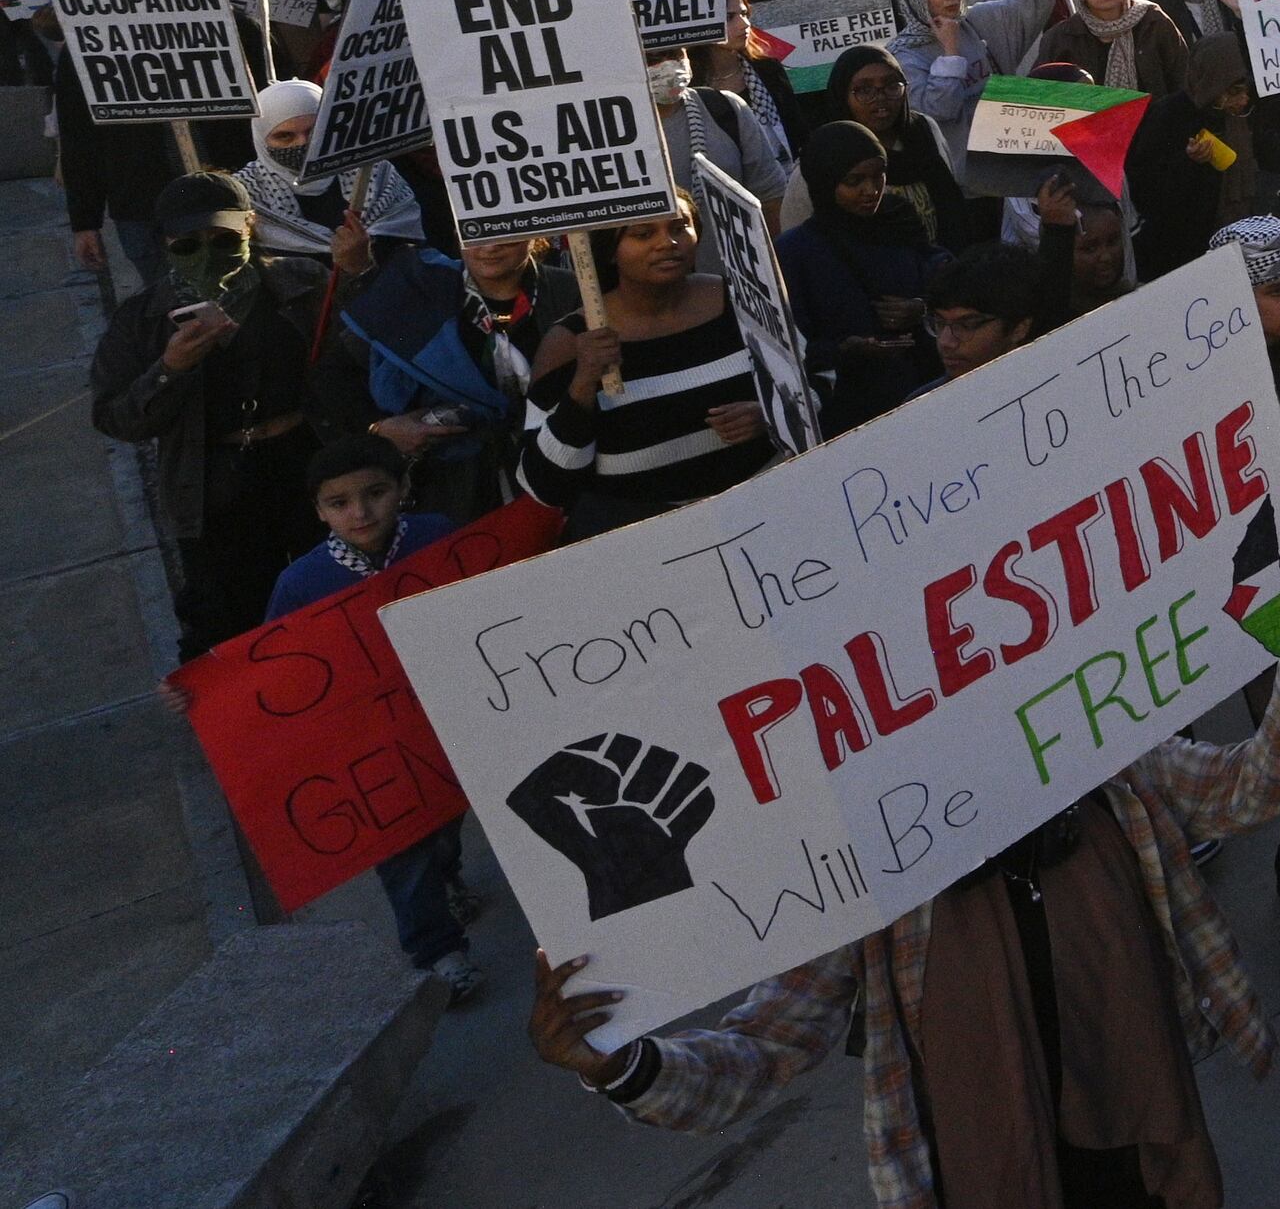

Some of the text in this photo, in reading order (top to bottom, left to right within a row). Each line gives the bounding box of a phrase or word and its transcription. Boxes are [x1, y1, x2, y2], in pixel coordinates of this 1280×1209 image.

[75, 21, 230, 53] IS A HUMAN
[799, 8, 893, 40] FREE FREE
[812, 26, 891, 53] PALESTINE
[83, 50, 242, 103] RIGHT!
[482, 27, 583, 95] ALL
[443, 110, 543, 169] U.S.
[556, 95, 638, 154] AID
[451, 150, 651, 211] TO ISRAEL!
[483, 197, 665, 233] Party for Socialism and Liberation
[472, 297, 1255, 712] From The River To The Sea
[716, 399, 1269, 805] PALESTINE
[711, 589, 1210, 943] Will Be FREE
